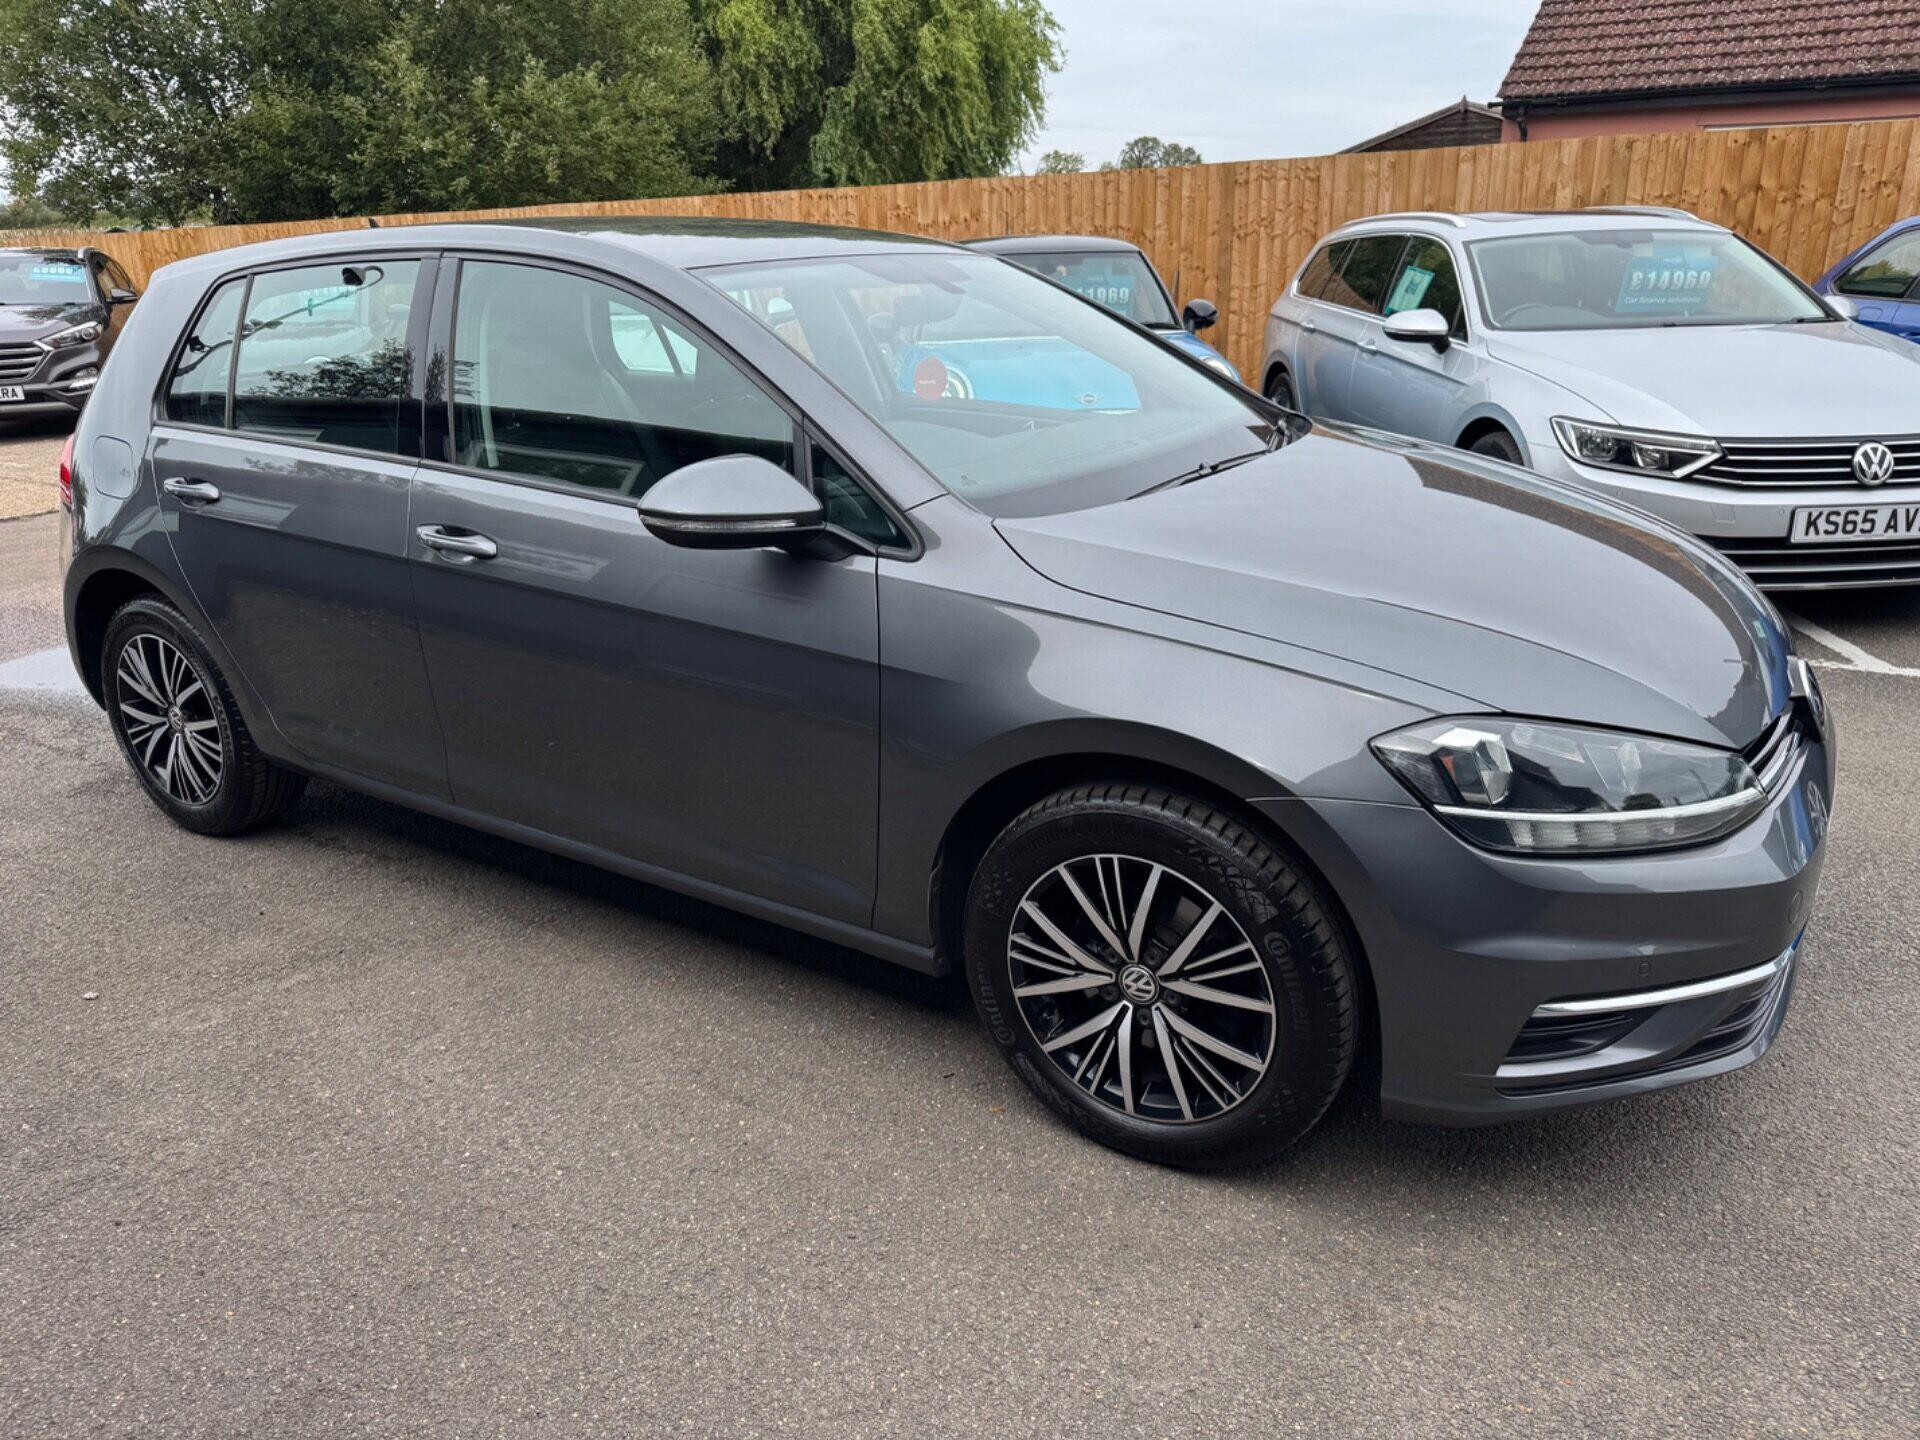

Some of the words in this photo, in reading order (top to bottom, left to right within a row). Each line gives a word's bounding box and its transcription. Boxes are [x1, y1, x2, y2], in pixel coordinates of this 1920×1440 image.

[1630, 271, 1712, 290] £14969
[1077, 287, 1129, 304] 1969
[0, 387, 19, 399] RA
[1804, 508, 1879, 537] KS65
[1883, 507, 1920, 534] AV
